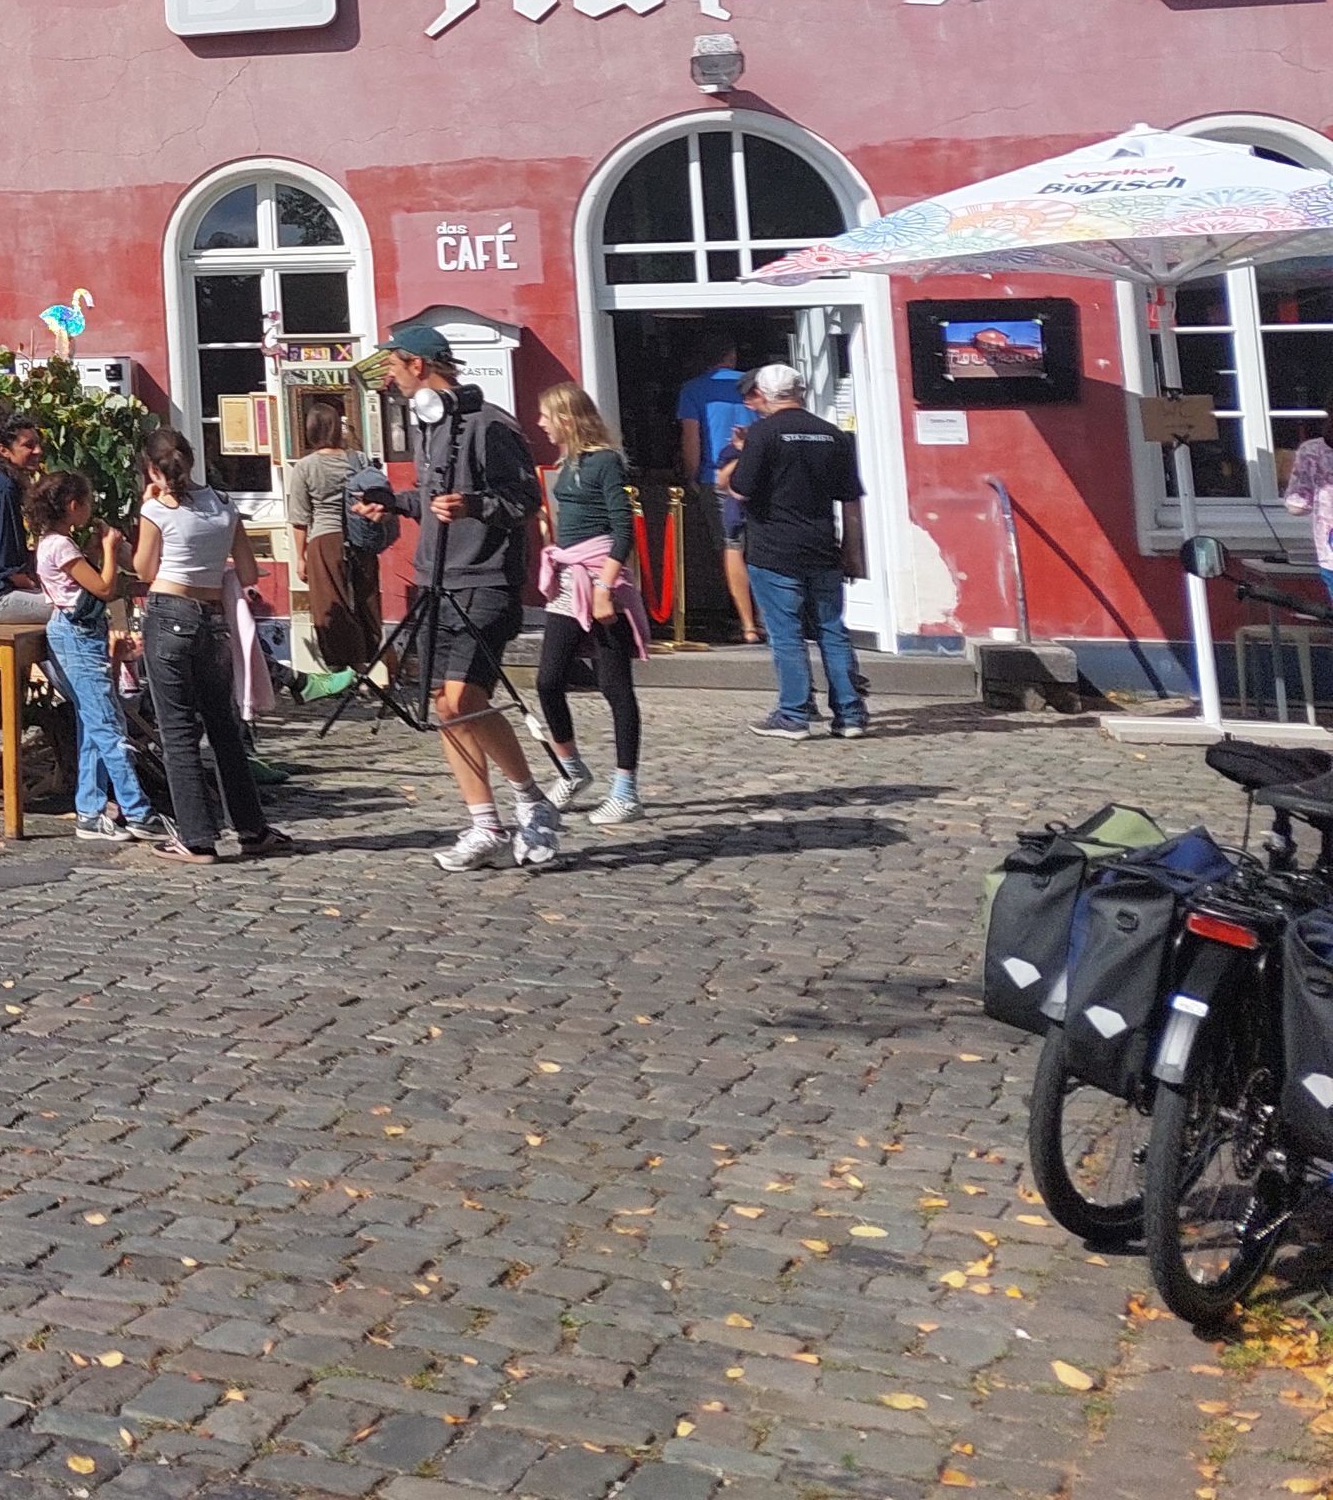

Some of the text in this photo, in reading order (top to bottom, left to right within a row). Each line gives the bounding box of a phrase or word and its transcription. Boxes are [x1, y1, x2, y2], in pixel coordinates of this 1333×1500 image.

[436, 221, 469, 235] das
[436, 221, 519, 271] CAFÉ
[458, 366, 503, 377] KASTEN
